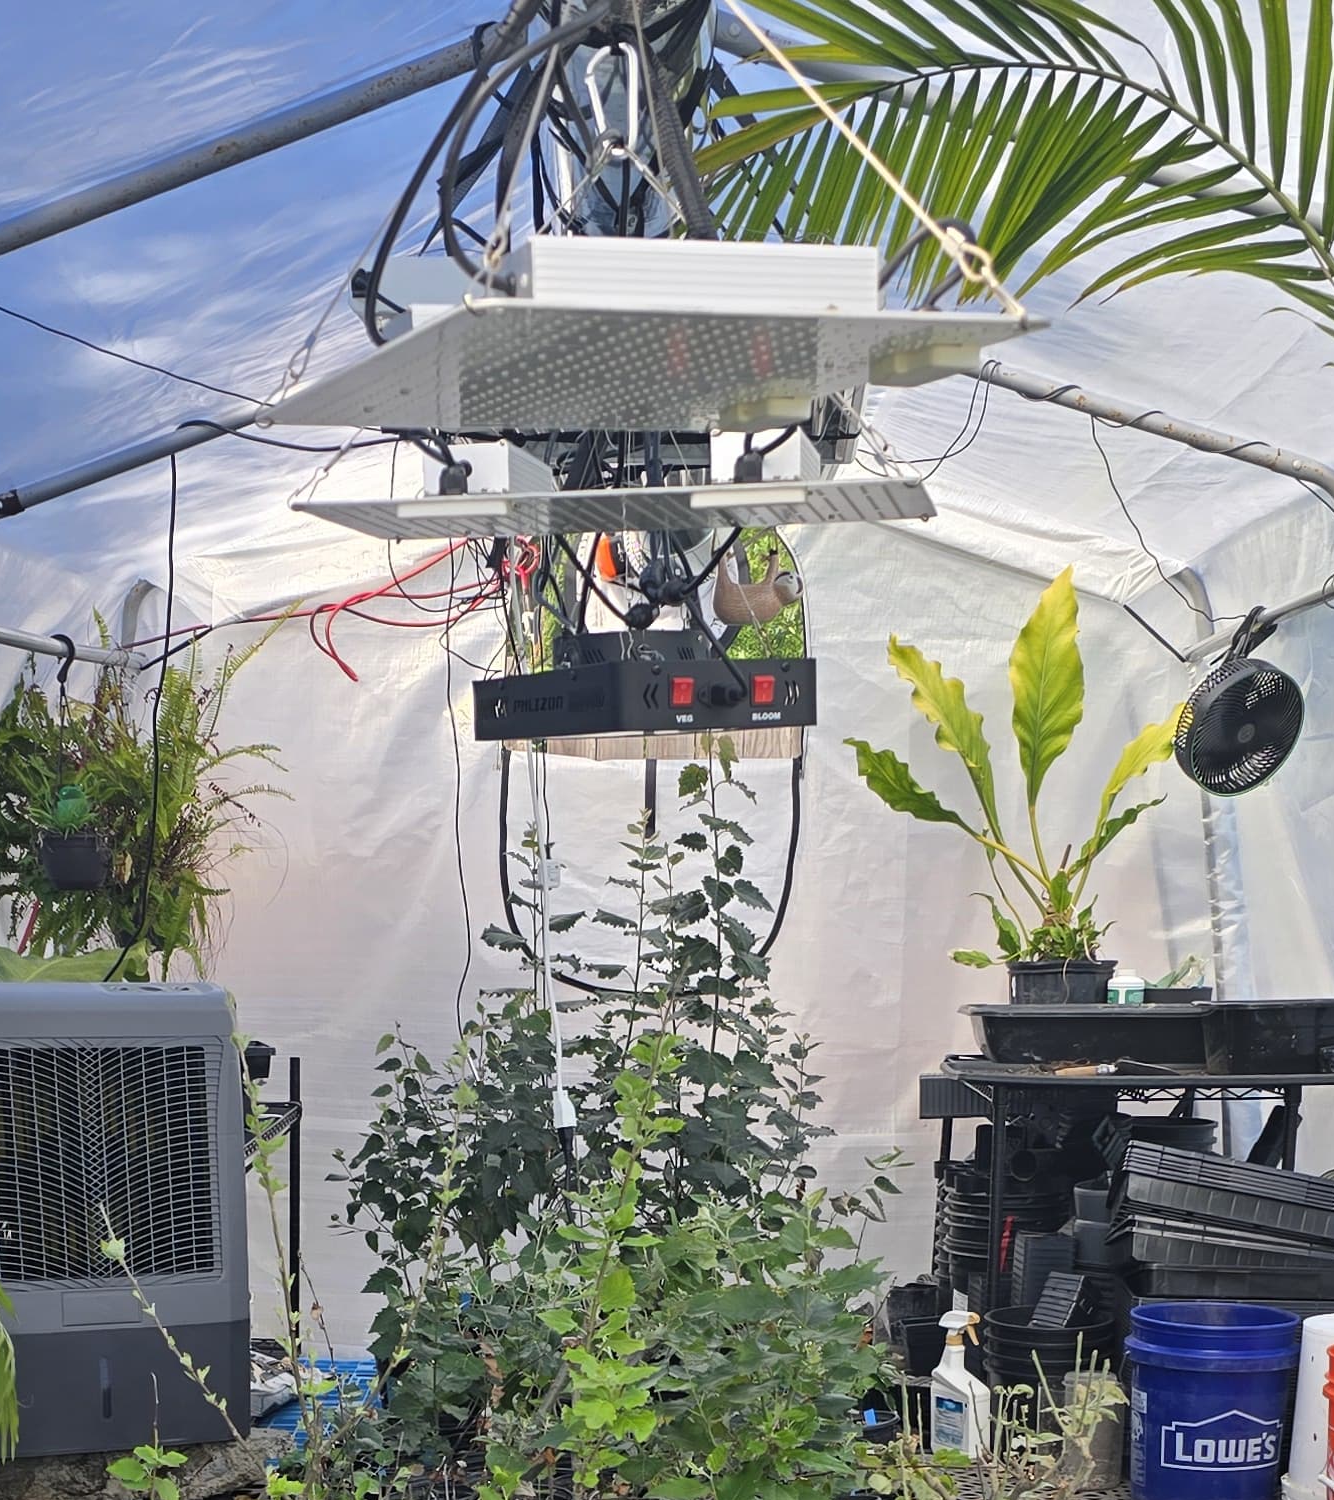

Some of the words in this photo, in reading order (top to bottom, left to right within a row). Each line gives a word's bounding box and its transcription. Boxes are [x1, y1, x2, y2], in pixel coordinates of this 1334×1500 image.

[676, 714, 694, 723] VEG
[751, 711, 781, 721] BLOOM
[1175, 1431, 1277, 1464] LOWE'S
